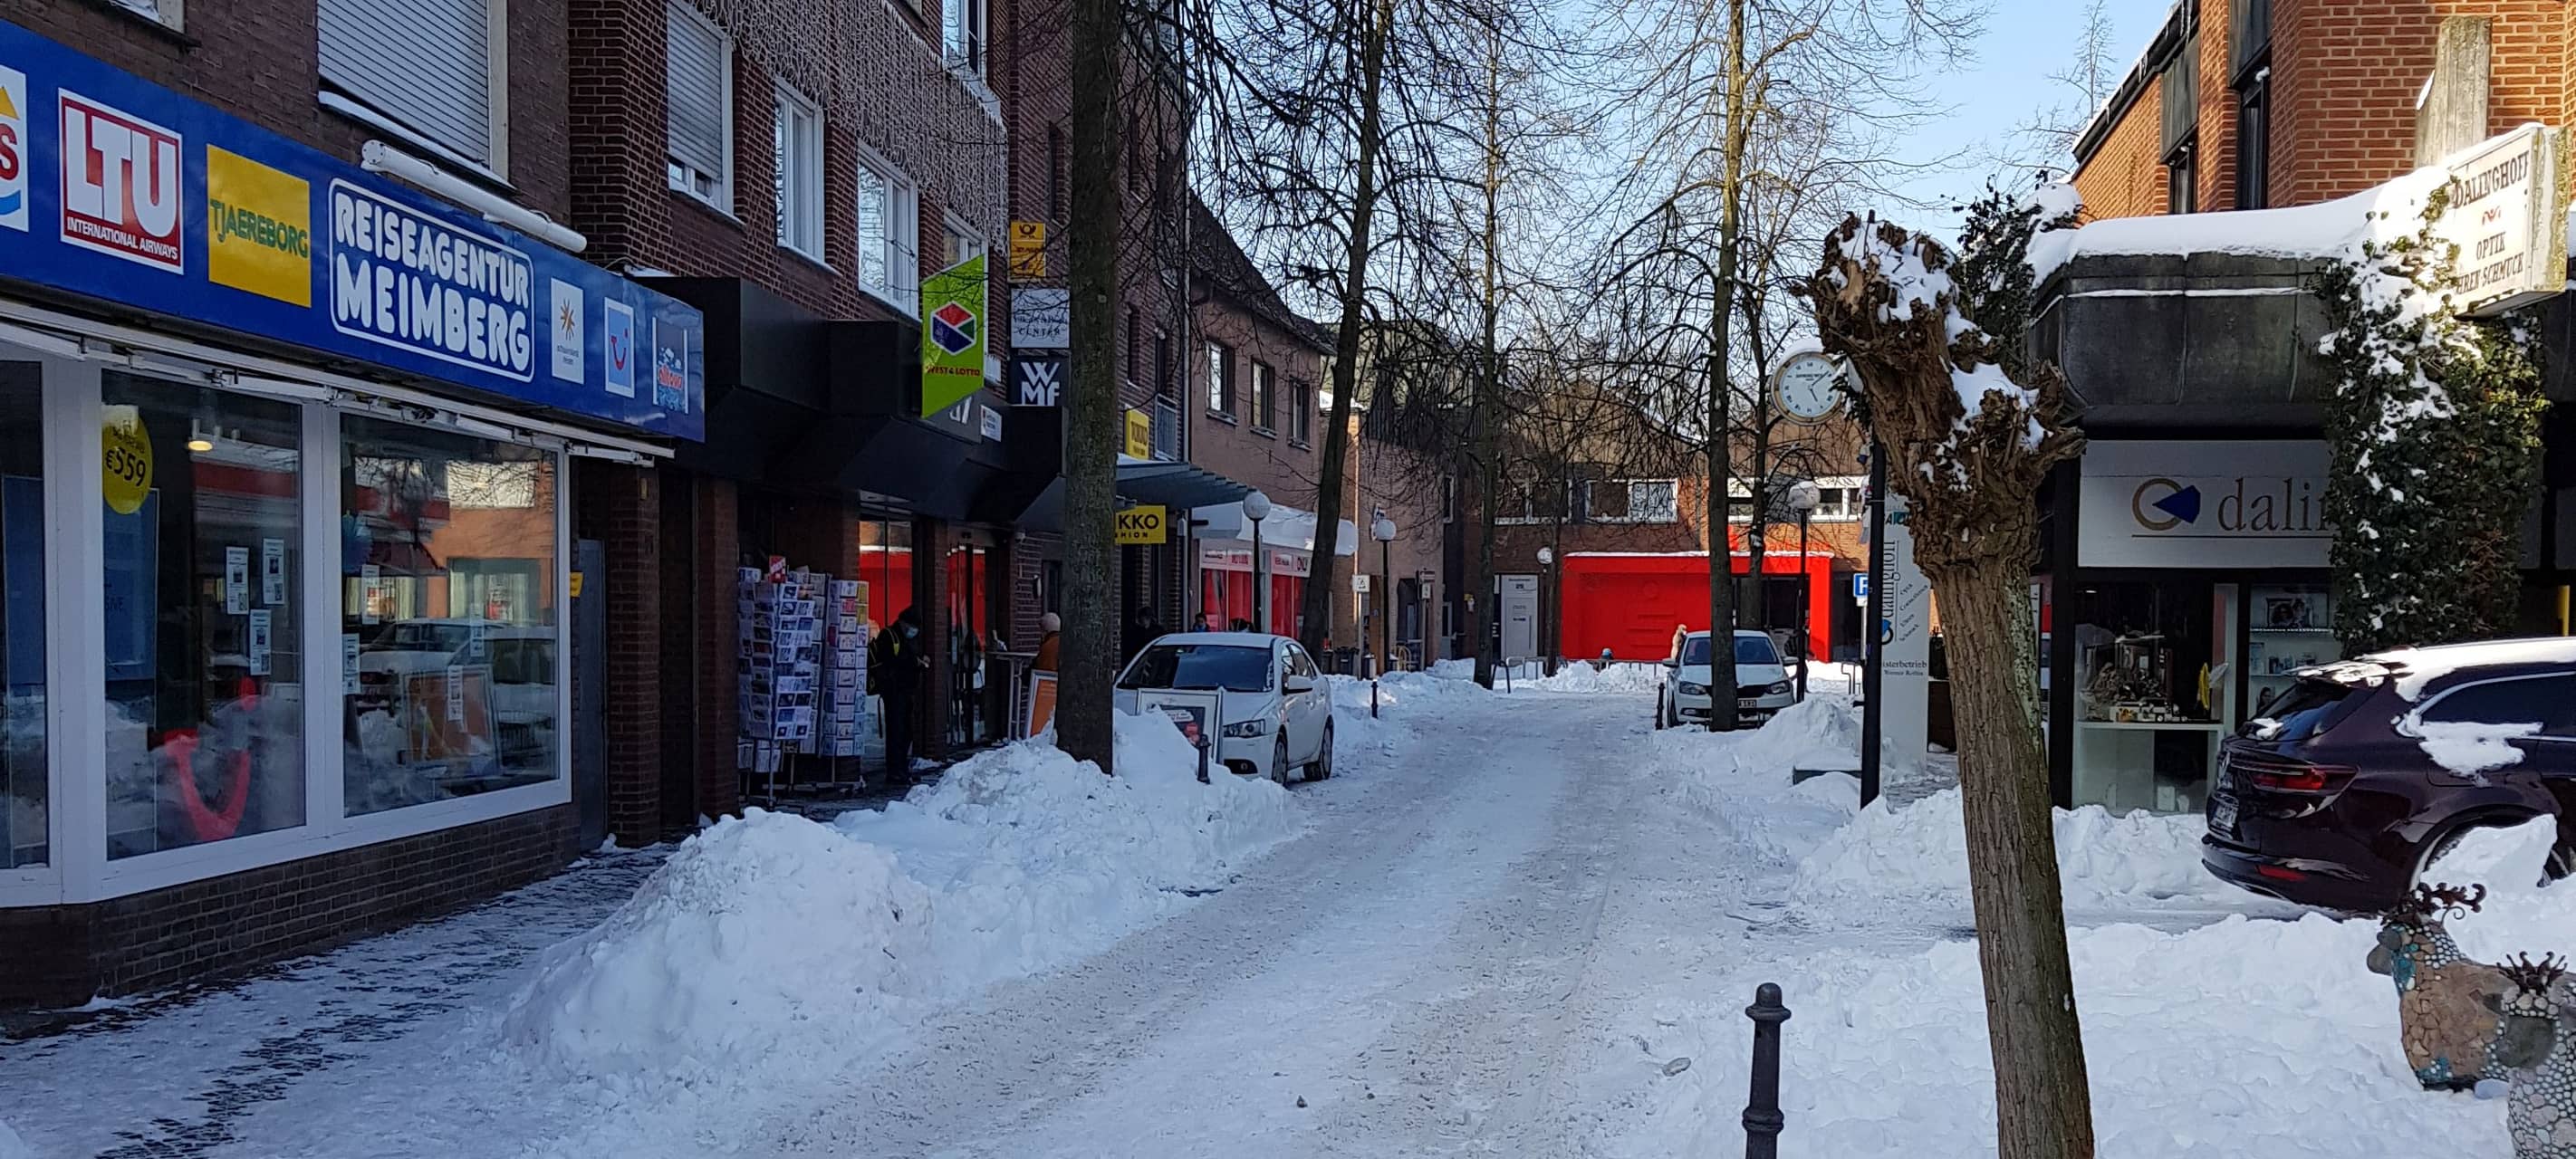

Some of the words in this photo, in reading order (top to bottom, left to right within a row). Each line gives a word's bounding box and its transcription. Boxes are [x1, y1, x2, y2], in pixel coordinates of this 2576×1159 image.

[64, 105, 177, 238] LTU
[2452, 149, 2530, 209] DALINGHOFF
[67, 216, 139, 249] INTERNATIONAL
[139, 237, 178, 261] AIRWAYS
[210, 198, 309, 259] TJAEREBORG
[335, 192, 529, 309] REISEAGENTUR
[2475, 231, 2506, 261] OPTIK
[336, 253, 530, 372] MEIMBERG
[1021, 362, 1060, 407] WMF
[1119, 513, 1159, 530] KKO
